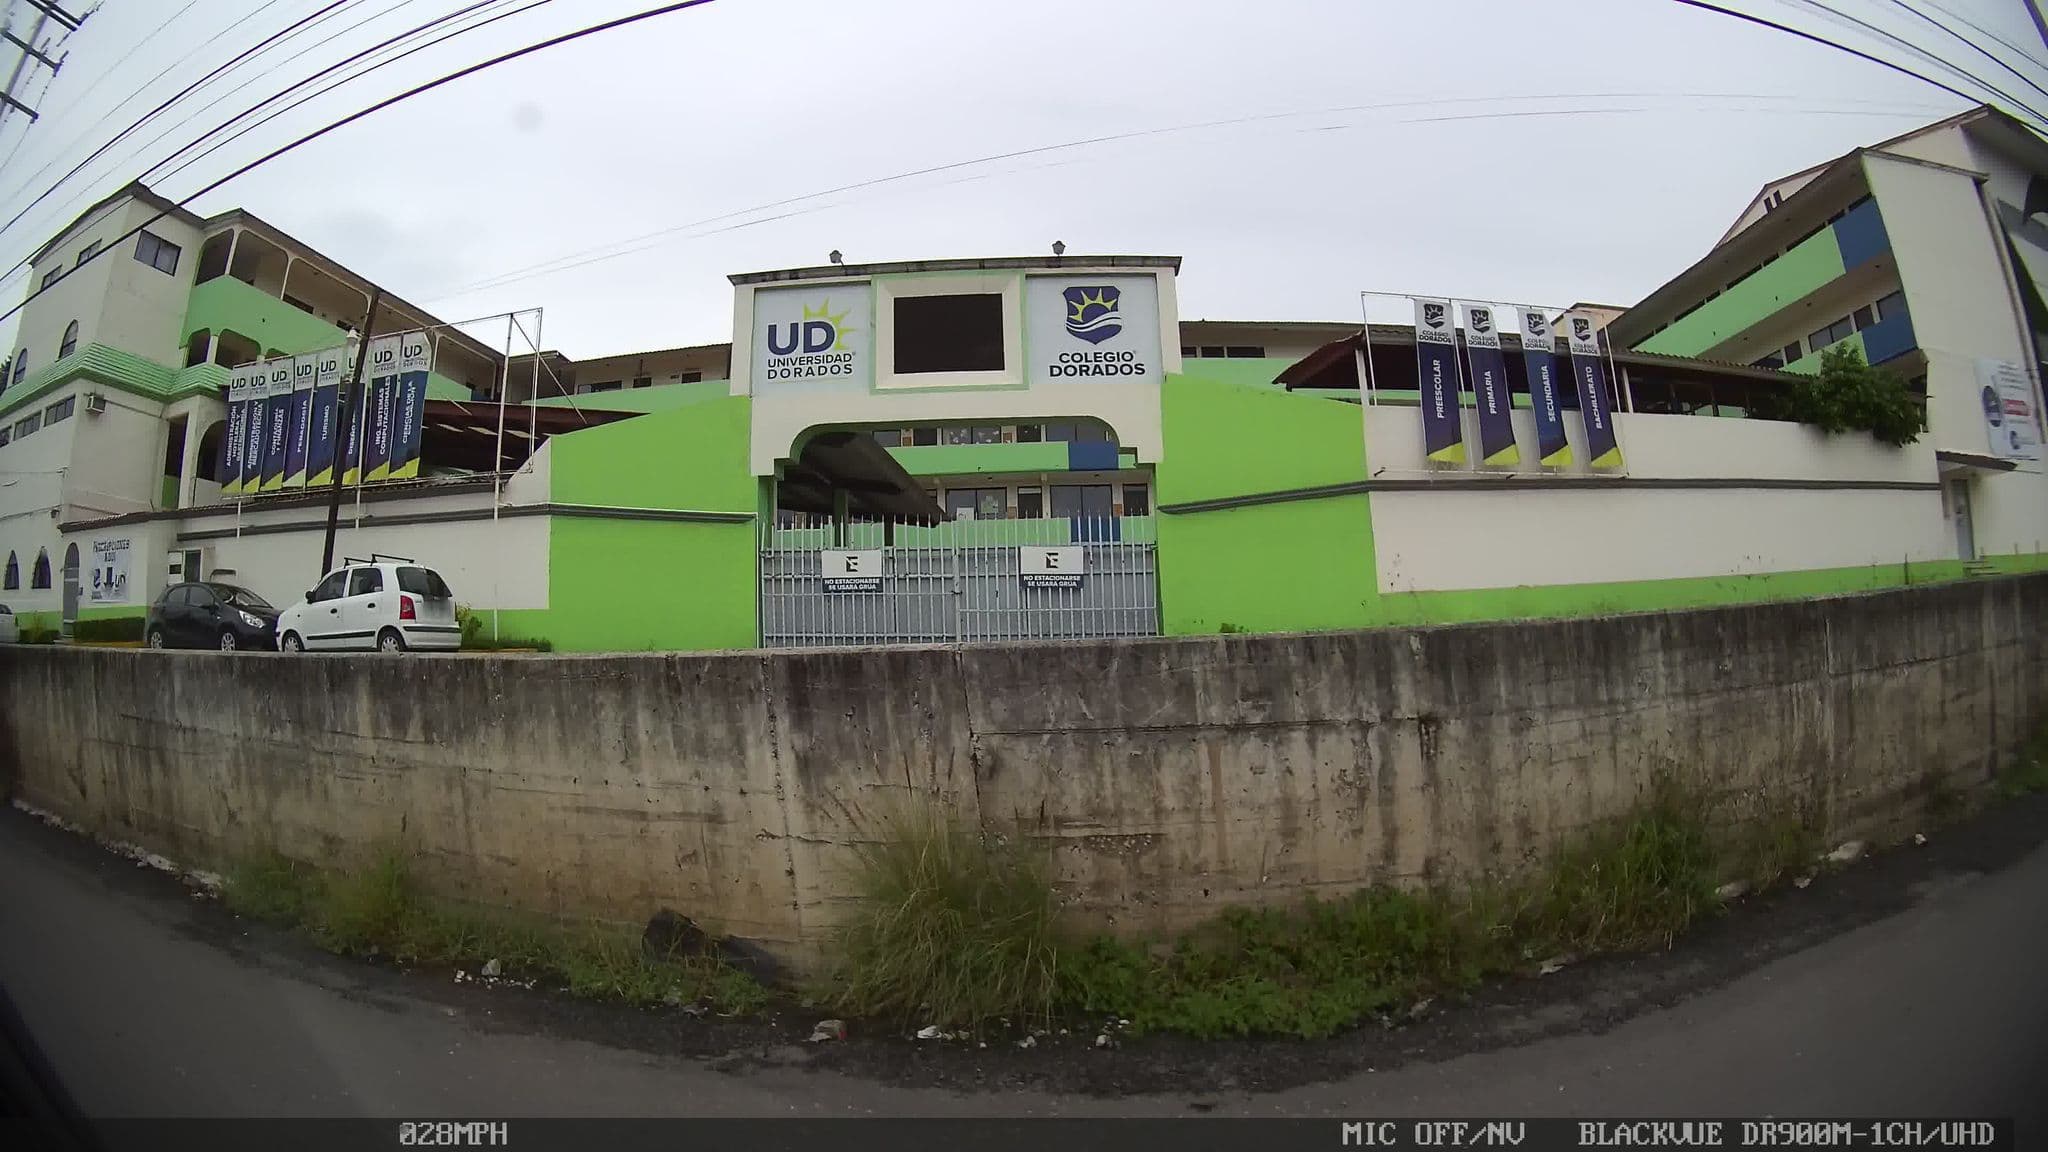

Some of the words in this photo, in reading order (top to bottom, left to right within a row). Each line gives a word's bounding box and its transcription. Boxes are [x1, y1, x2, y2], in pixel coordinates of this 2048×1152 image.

[767, 320, 836, 356] UD
[1419, 334, 1452, 343] DORADOS
[374, 350, 393, 364] UD
[404, 345, 423, 358] UD
[1059, 351, 1134, 363] COLEGIO
[320, 359, 337, 373] UD
[767, 353, 852, 368] UNIVERSIDAD
[271, 371, 288, 383] UD
[296, 364, 312, 377] UD
[767, 364, 852, 380] DORADOS
[1049, 363, 1146, 377] DORADOS
[231, 378, 247, 389] UD
[251, 375, 266, 387] UD
[1433, 359, 1445, 419] PREESCOLAR
[1484, 370, 1497, 415] PRIMARIA
[1541, 365, 1556, 422] SECUNDARIA
[1585, 366, 1603, 430] BACHILLERATO
[376, 388, 385, 427] SISTEMAS
[379, 376, 391, 455] COMPUTACIONALES
[321, 405, 330, 441] TURISMO
